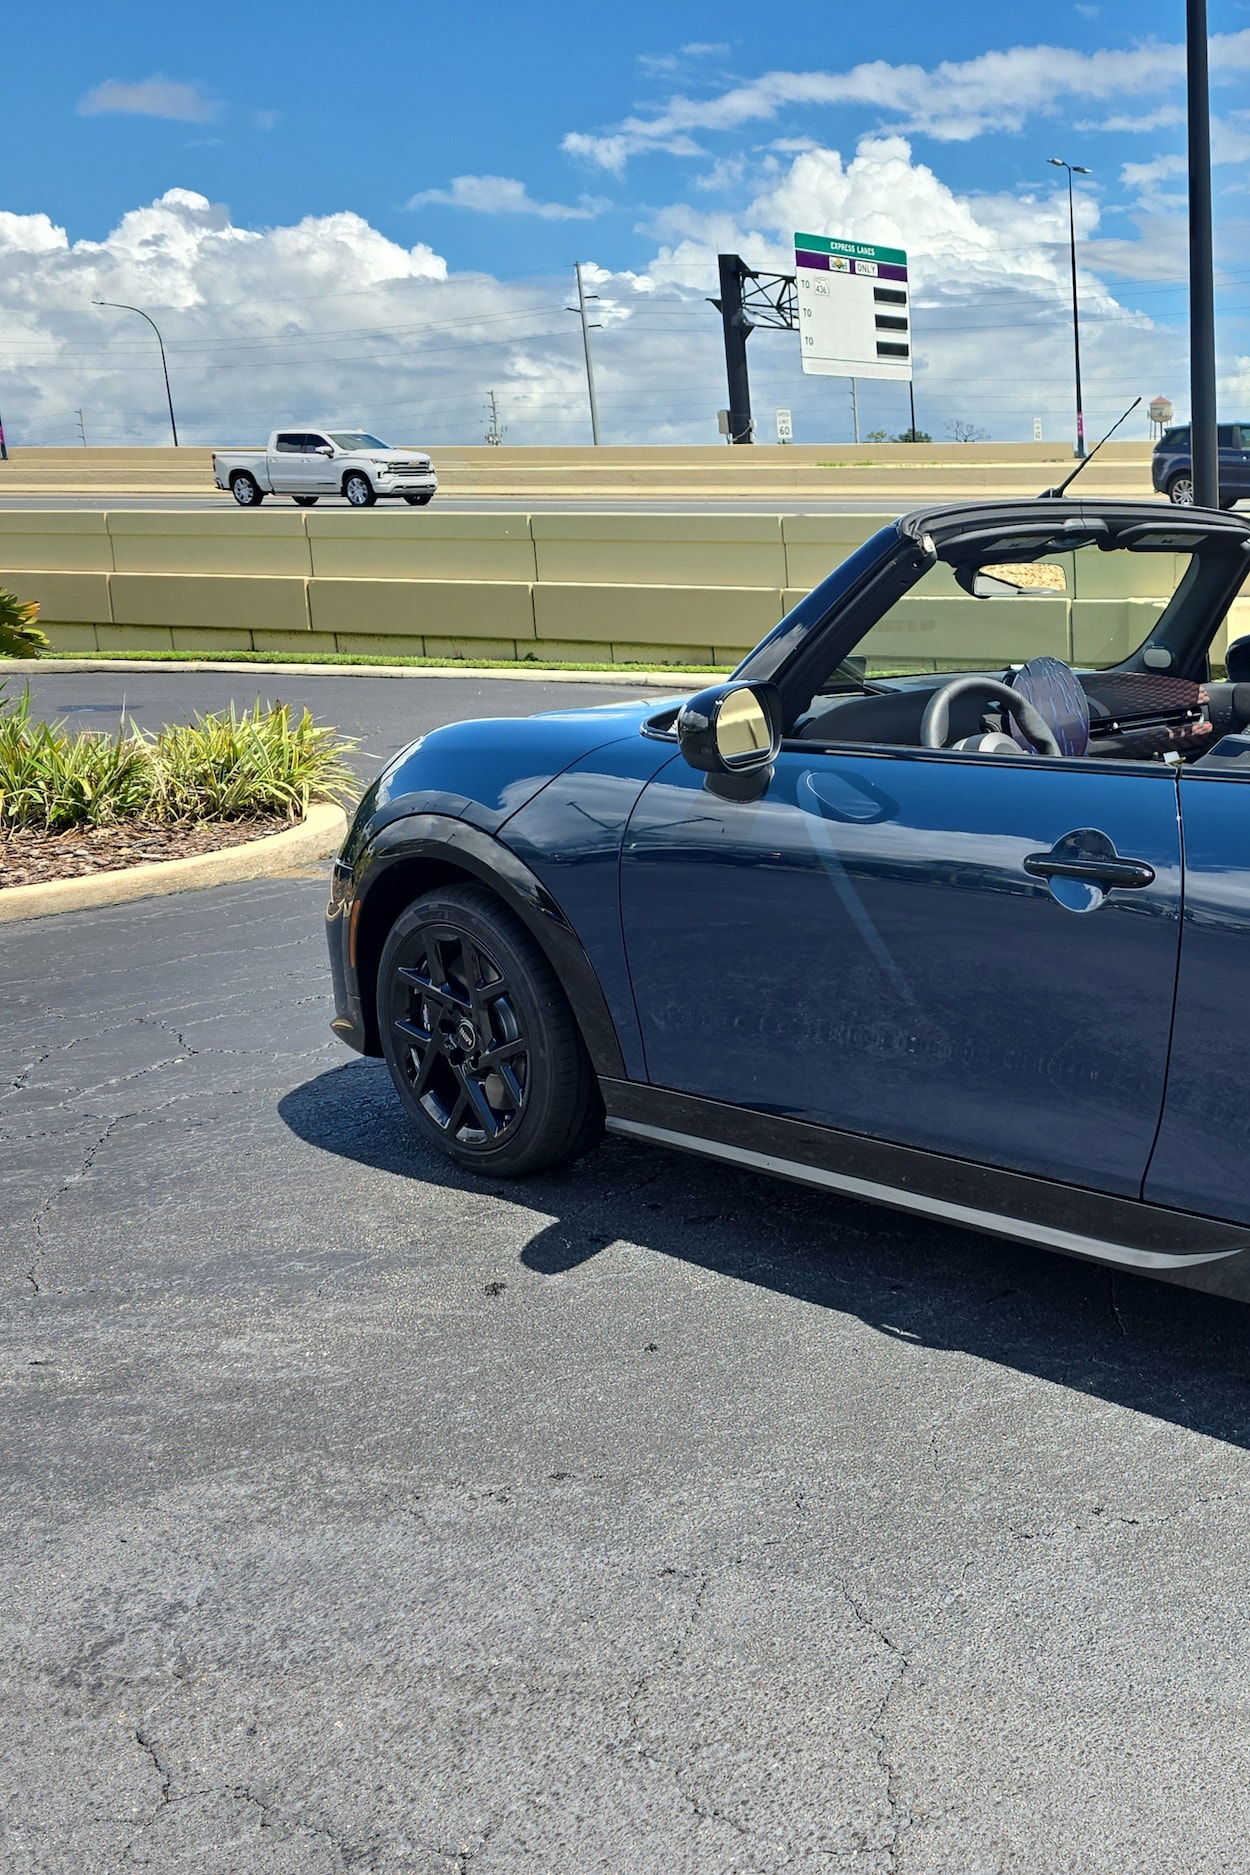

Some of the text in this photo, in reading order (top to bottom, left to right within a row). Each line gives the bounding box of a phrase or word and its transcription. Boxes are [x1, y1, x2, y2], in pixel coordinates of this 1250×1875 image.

[830, 241, 875, 256] EXPRESS LANES
[857, 263, 876, 274] ONLY
[801, 279, 810, 289] TO
[803, 308, 812, 317] TO
[804, 336, 814, 346] TO
[779, 426, 790, 435] 60
